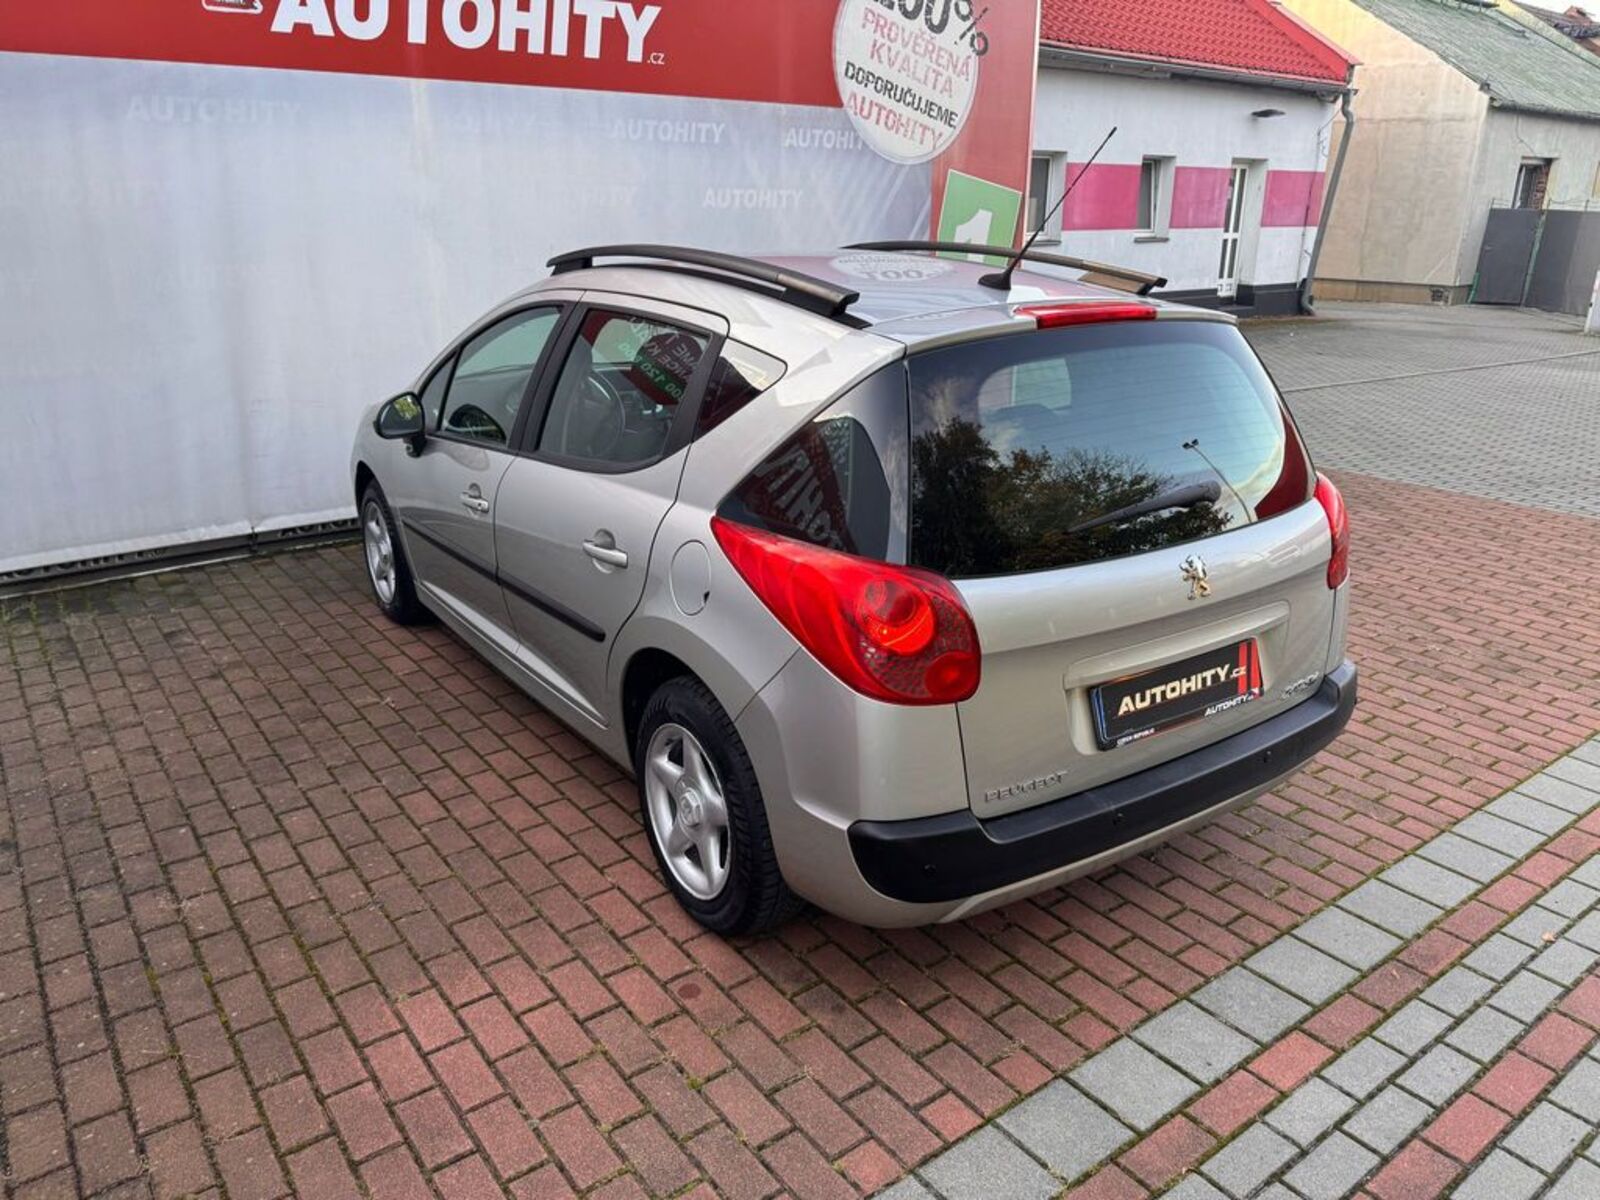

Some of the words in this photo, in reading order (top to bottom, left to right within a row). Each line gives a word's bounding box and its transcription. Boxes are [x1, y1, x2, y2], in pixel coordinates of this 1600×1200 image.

[844, 61, 958, 129] DOPORUČUJEME
[869, 38, 953, 98] KVALITA
[611, 118, 726, 145] AUTOHITY
[848, 92, 943, 151] AUTOHITY
[702, 187, 803, 209] AUTOHITY
[953, 208, 993, 262] 1
